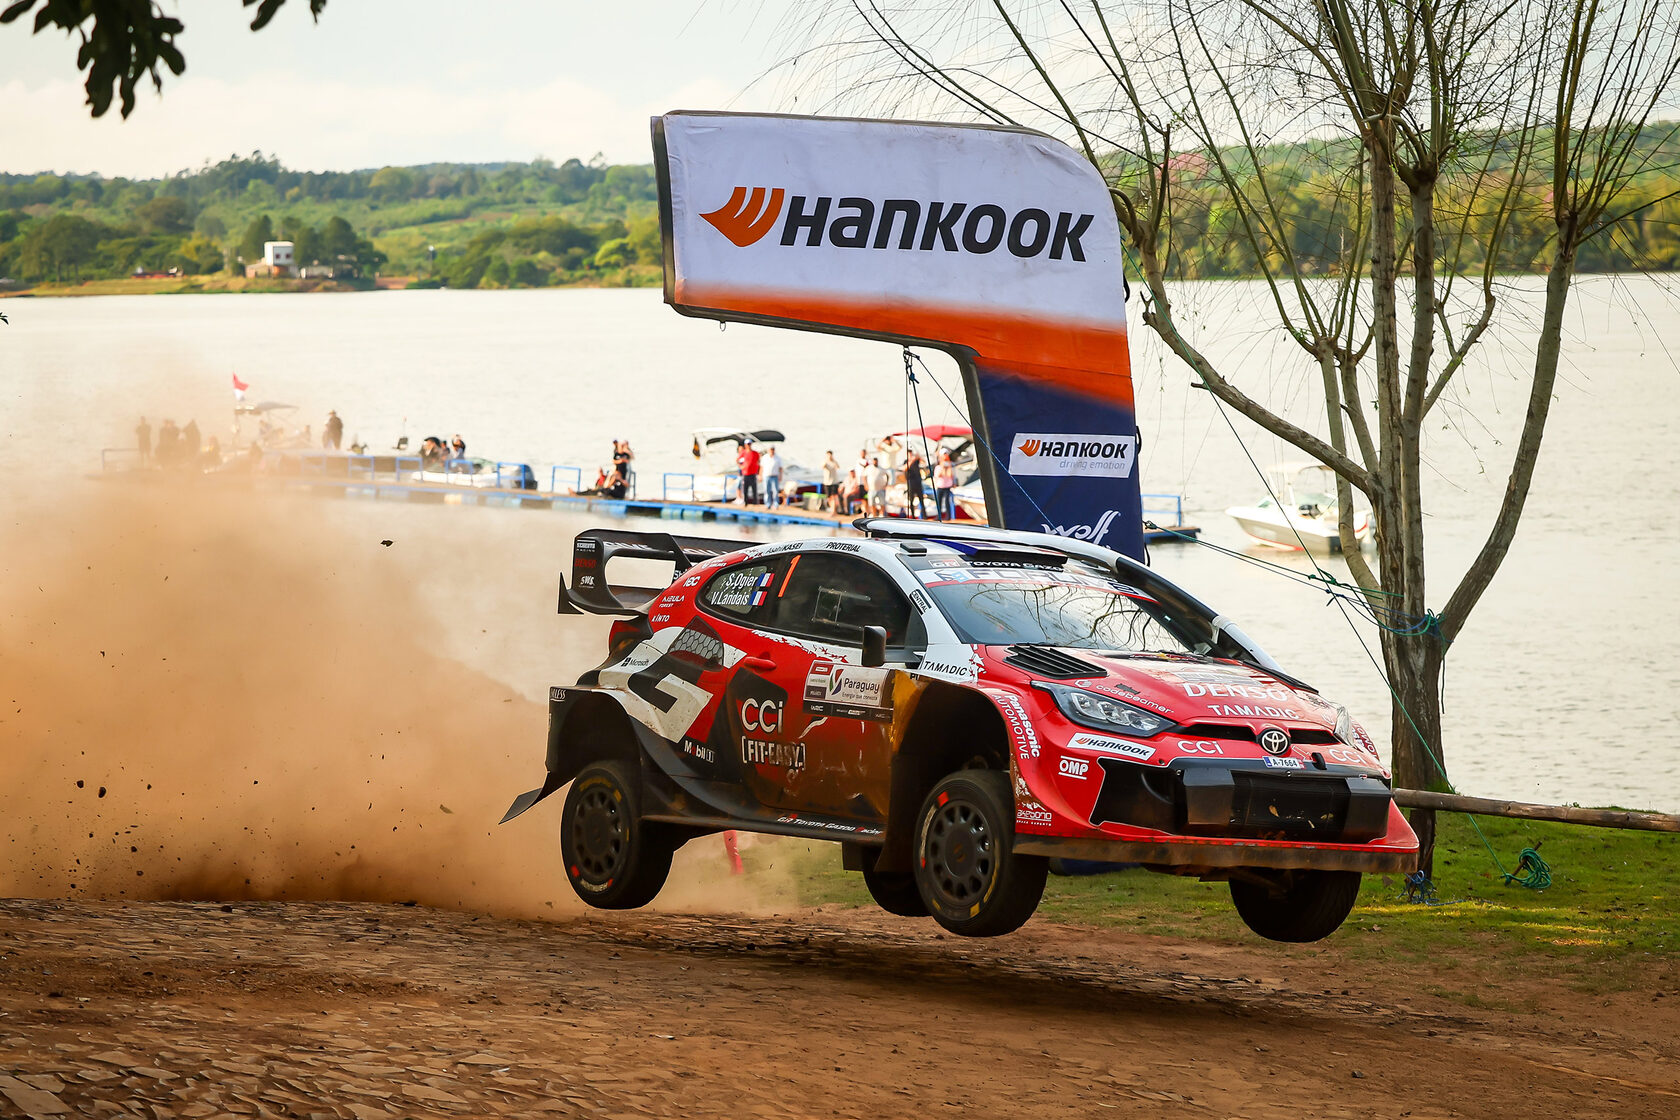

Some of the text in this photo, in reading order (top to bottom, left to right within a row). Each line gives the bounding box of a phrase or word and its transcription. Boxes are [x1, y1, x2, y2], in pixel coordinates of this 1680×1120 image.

[1059, 460, 1125, 470] driving emotion
[825, 541, 861, 553] PROTERIAL
[967, 560, 1021, 568] TOYOTA
[726, 572, 758, 591] S.Ogier
[777, 554, 802, 598] 1
[710, 591, 750, 606] V.Landais
[924, 661, 967, 676] TAMADIC
[843, 678, 880, 694] Paraguay
[1183, 682, 1288, 702] DENSO
[1207, 704, 1300, 720] TAMADIC
[991, 694, 1030, 760] AUTOMOTIVE
[1004, 694, 1041, 758] Panasonic
[684, 740, 706, 760] Mobil
[1059, 759, 1089, 776] OMP
